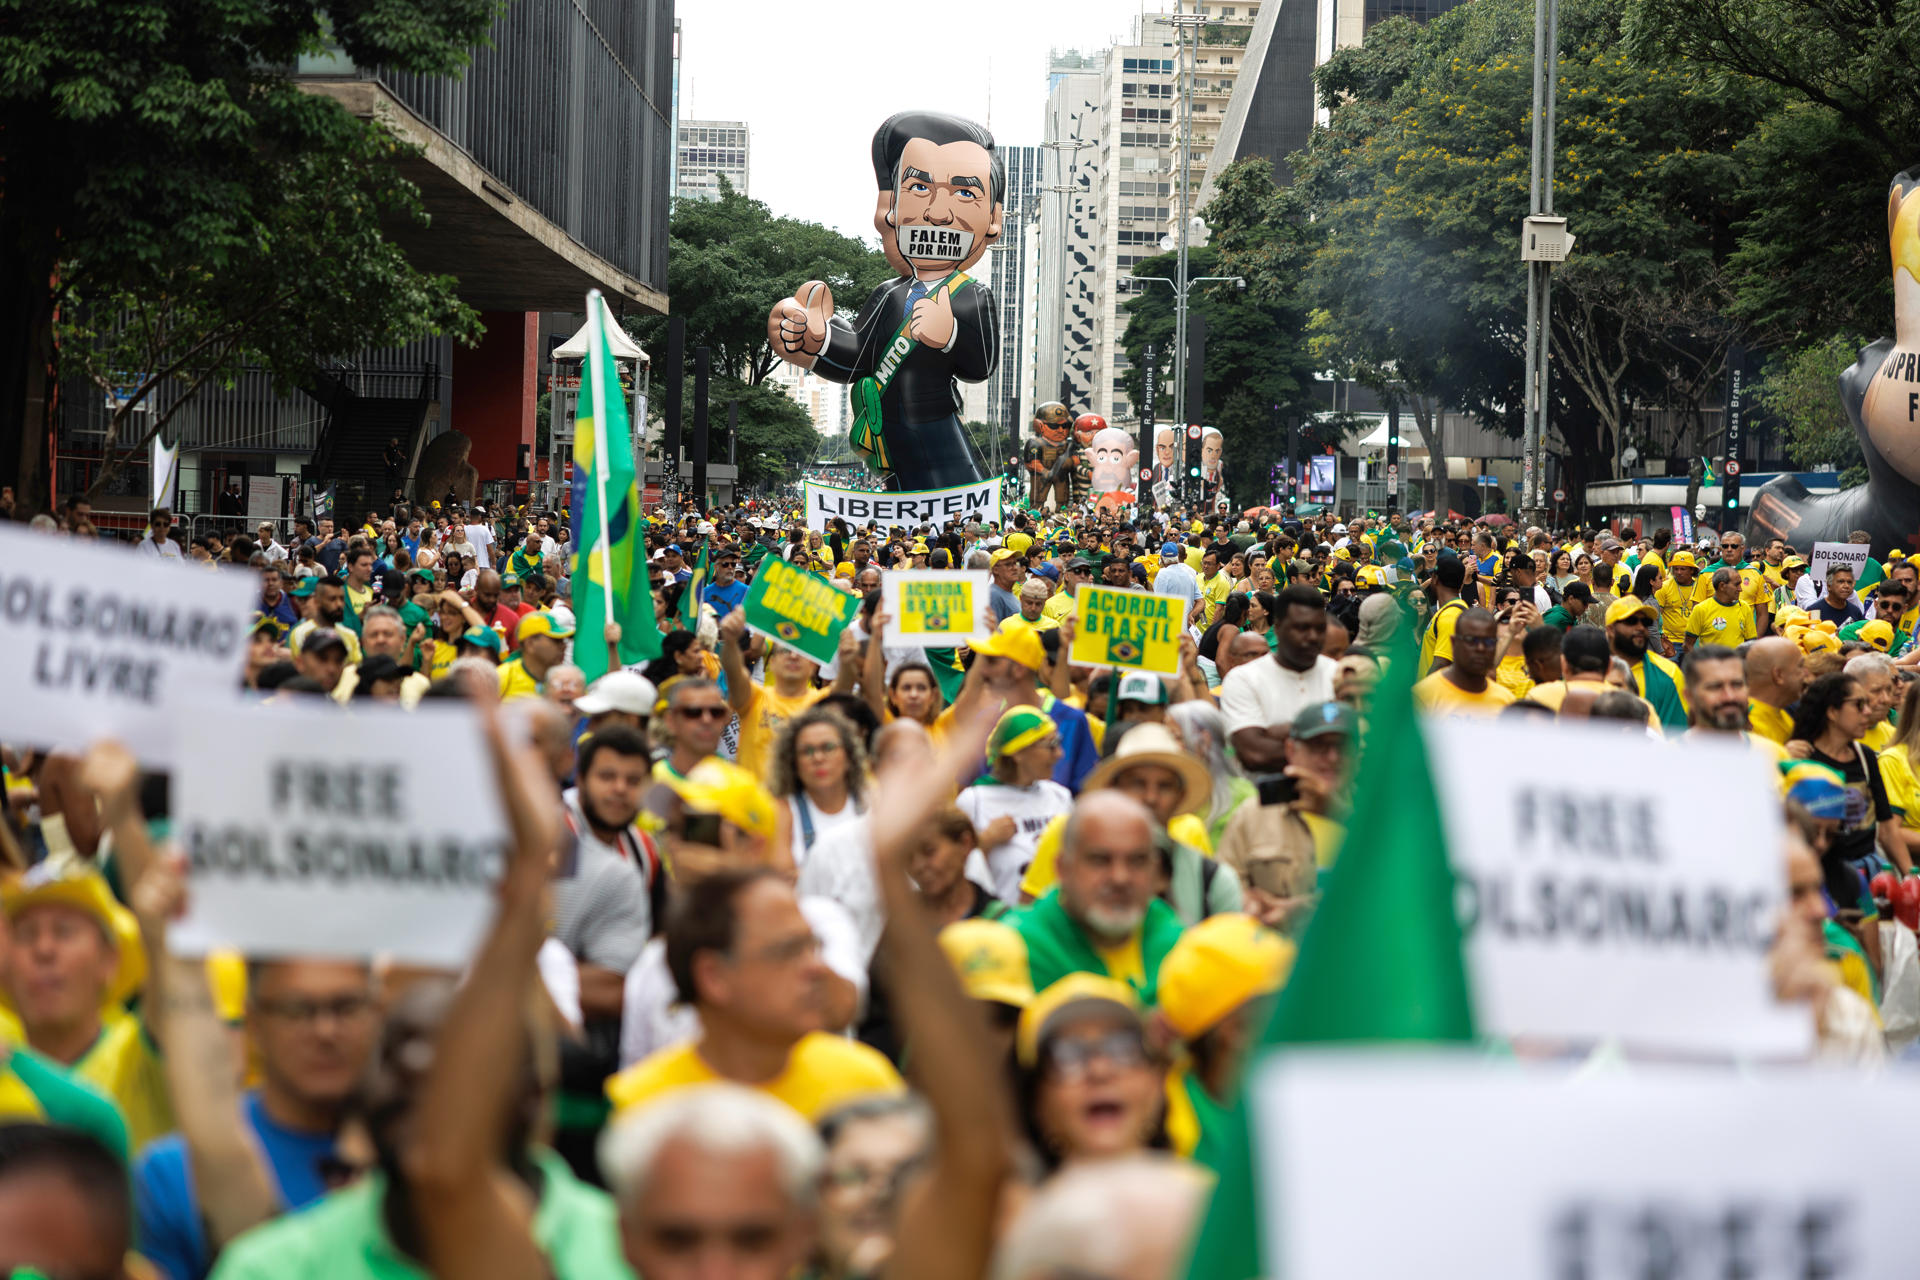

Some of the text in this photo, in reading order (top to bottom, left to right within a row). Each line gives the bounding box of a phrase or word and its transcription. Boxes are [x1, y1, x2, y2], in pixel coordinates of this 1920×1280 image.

[909, 244, 962, 257] POR MIM
[911, 230, 960, 245] FALEM
[875, 336, 911, 385] MITO
[1883, 351, 1920, 383] SUPR
[1144, 367, 1153, 425] R. Pamplona
[1730, 369, 1740, 459] Al. Casa Branca
[818, 489, 990, 519] LIBERTEM
[1815, 550, 1867, 562] BOLSONARO
[0, 577, 238, 659] OLSONARO
[761, 583, 832, 636] BRASIL
[906, 598, 966, 613] BRASIL
[1085, 614, 1170, 642] BRASIL
[34, 642, 159, 703] LIVRE
[268, 759, 402, 819] FREE
[1514, 786, 1661, 864] FREE
[1450, 871, 1773, 950] OLSONARO
